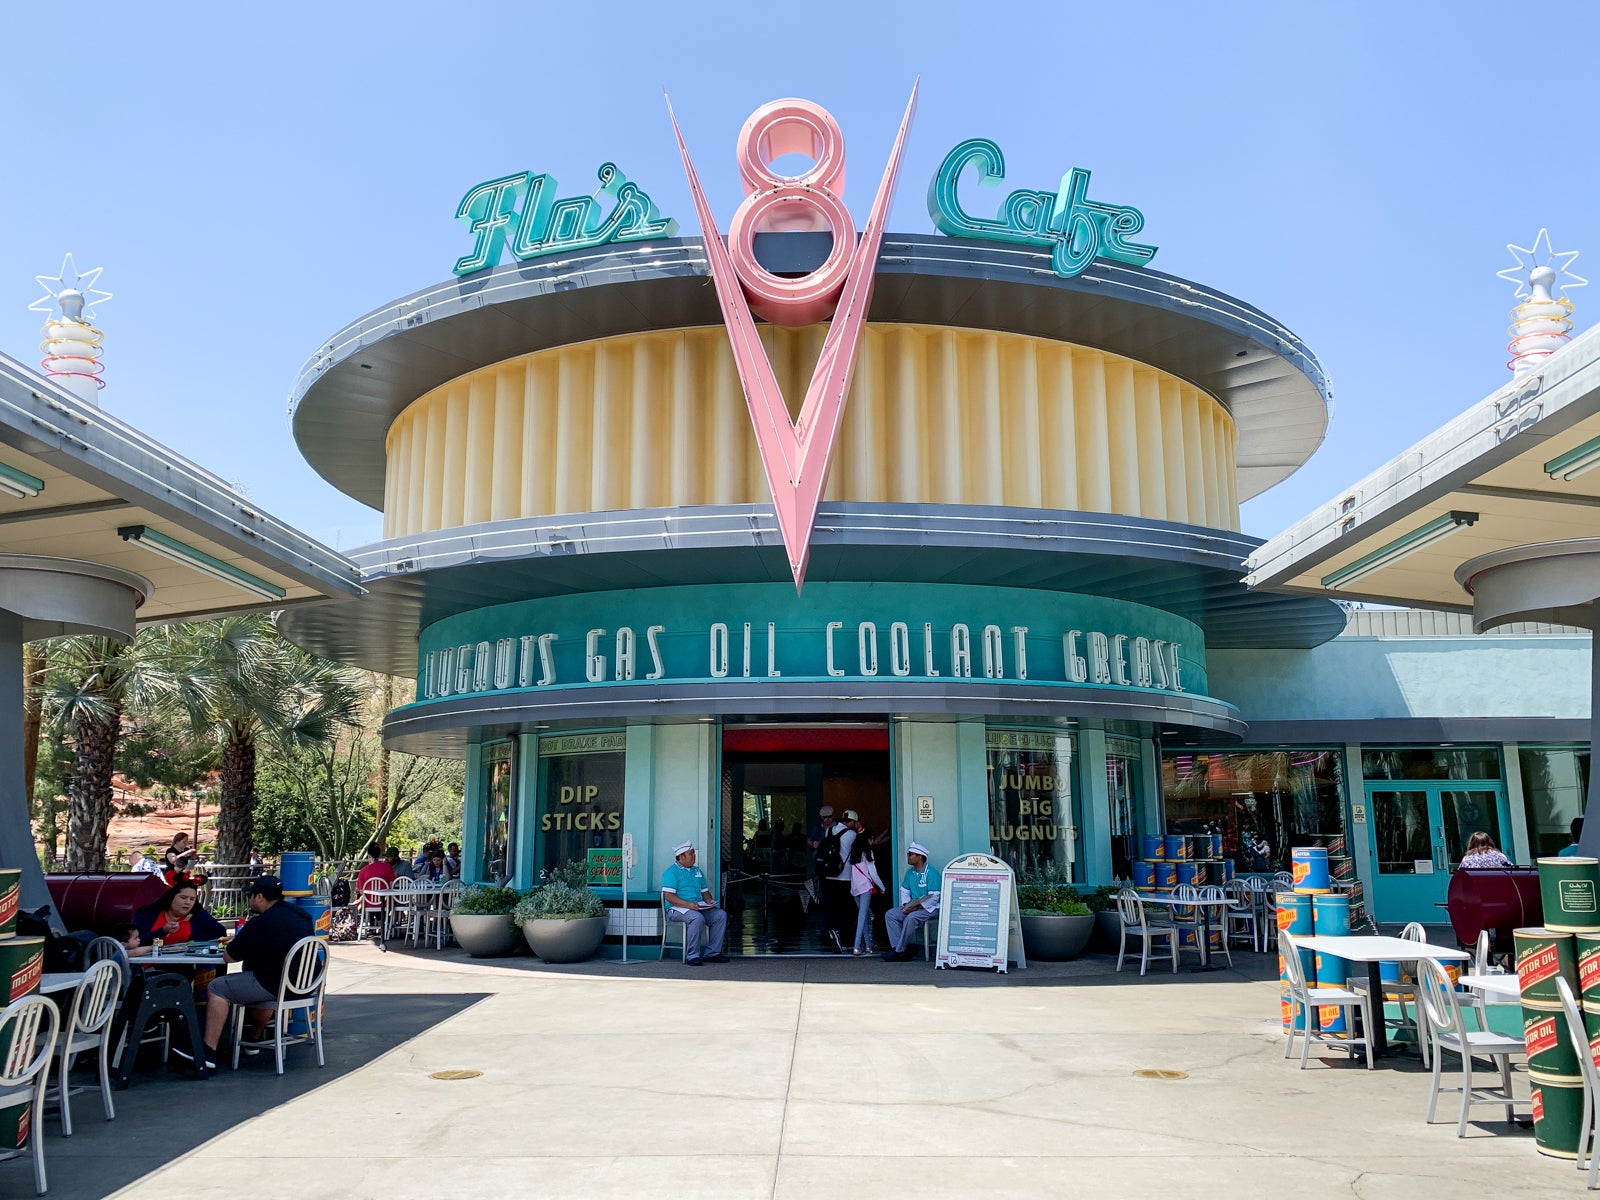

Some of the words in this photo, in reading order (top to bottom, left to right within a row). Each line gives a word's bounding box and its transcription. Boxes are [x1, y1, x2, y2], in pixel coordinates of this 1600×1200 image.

[453, 161, 681, 276] Flo's
[926, 137, 1160, 279] Cafe
[425, 633, 559, 699] LUGNUTS
[586, 625, 665, 682] GAS
[710, 622, 780, 678] OIL
[826, 621, 1029, 680] COOLANT
[1063, 629, 1186, 692] GREASE
[562, 735, 598, 750] BRAKE
[601, 734, 626, 747] PAD
[560, 785, 598, 804] DIP
[1020, 799, 1053, 816] BIG
[541, 812, 621, 831] STICKS
[989, 825, 1079, 841] LUGNUTS
[1541, 951, 1557, 966] OIL
[1540, 1024, 1555, 1038] OIL
